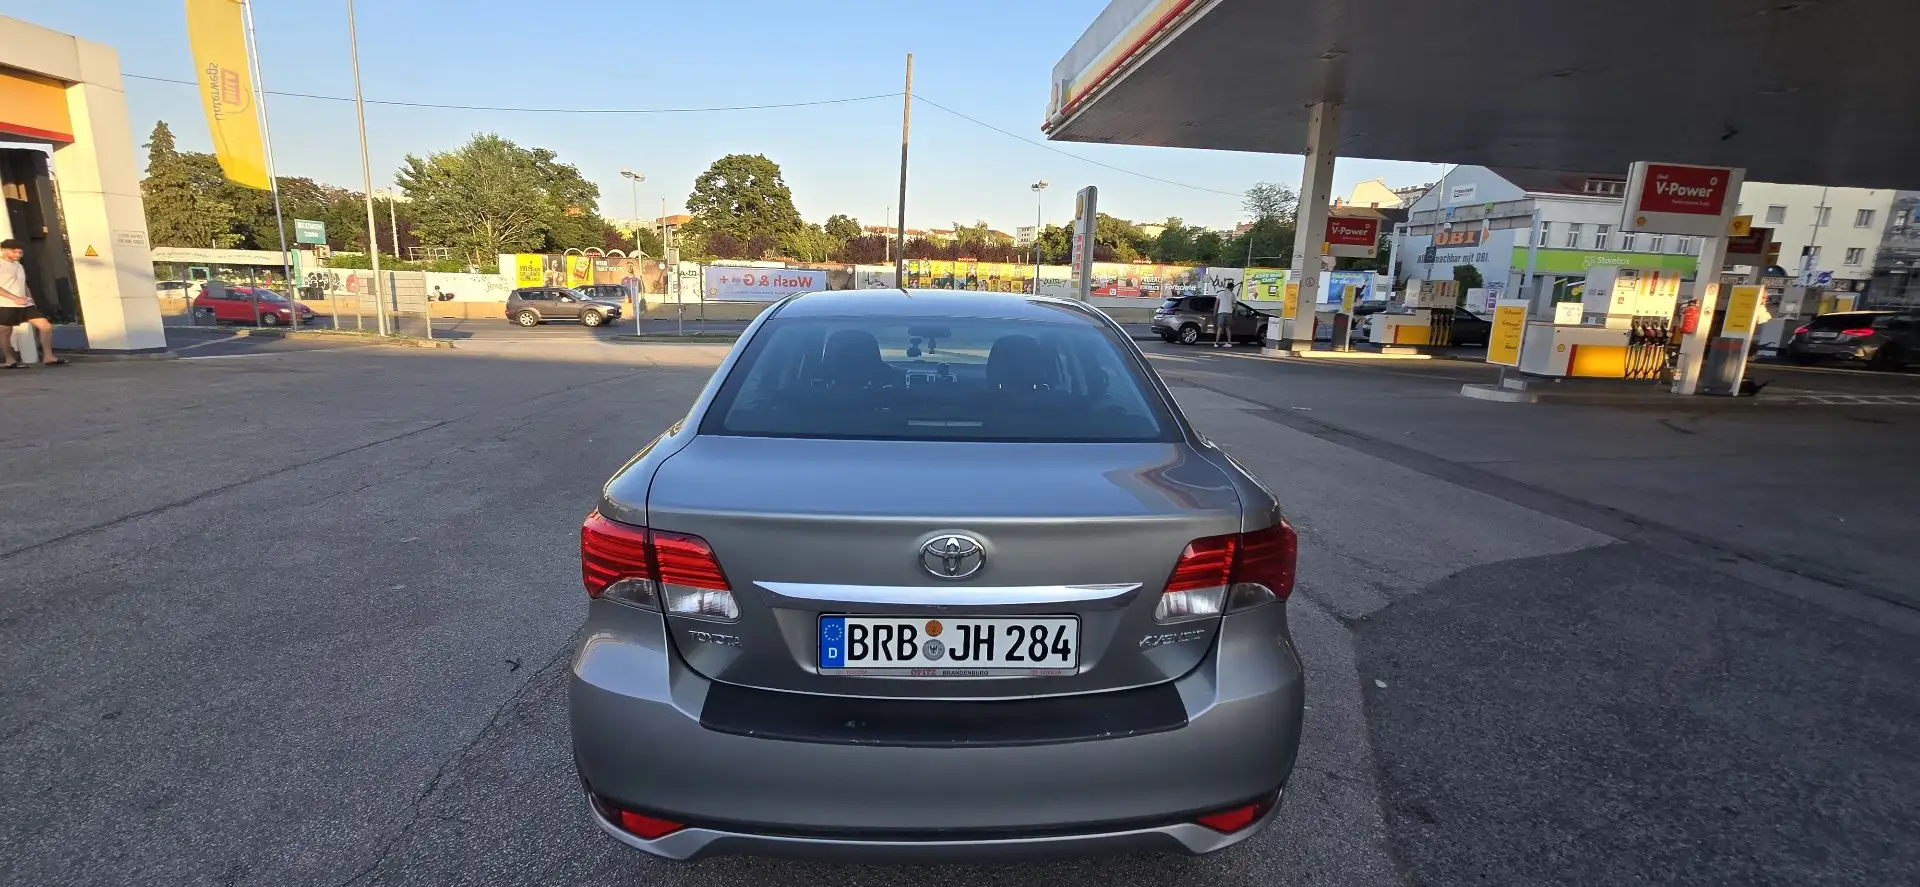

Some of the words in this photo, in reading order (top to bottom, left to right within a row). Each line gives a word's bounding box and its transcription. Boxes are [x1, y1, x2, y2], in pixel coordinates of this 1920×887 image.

[1656, 181, 1713, 197] V-Power
[1331, 226, 1368, 236] V-Power
[1434, 230, 1475, 246] OBI
[1435, 253, 1461, 263] machbar
[1463, 253, 1474, 263] mit
[1475, 252, 1490, 263] OBI.
[1596, 256, 1630, 265] Storebox
[848, 624, 918, 661] BRB
[949, 625, 995, 662] JH
[1005, 625, 1072, 662] 284
[828, 647, 838, 659] D
[910, 668, 937, 676] OPITZ
